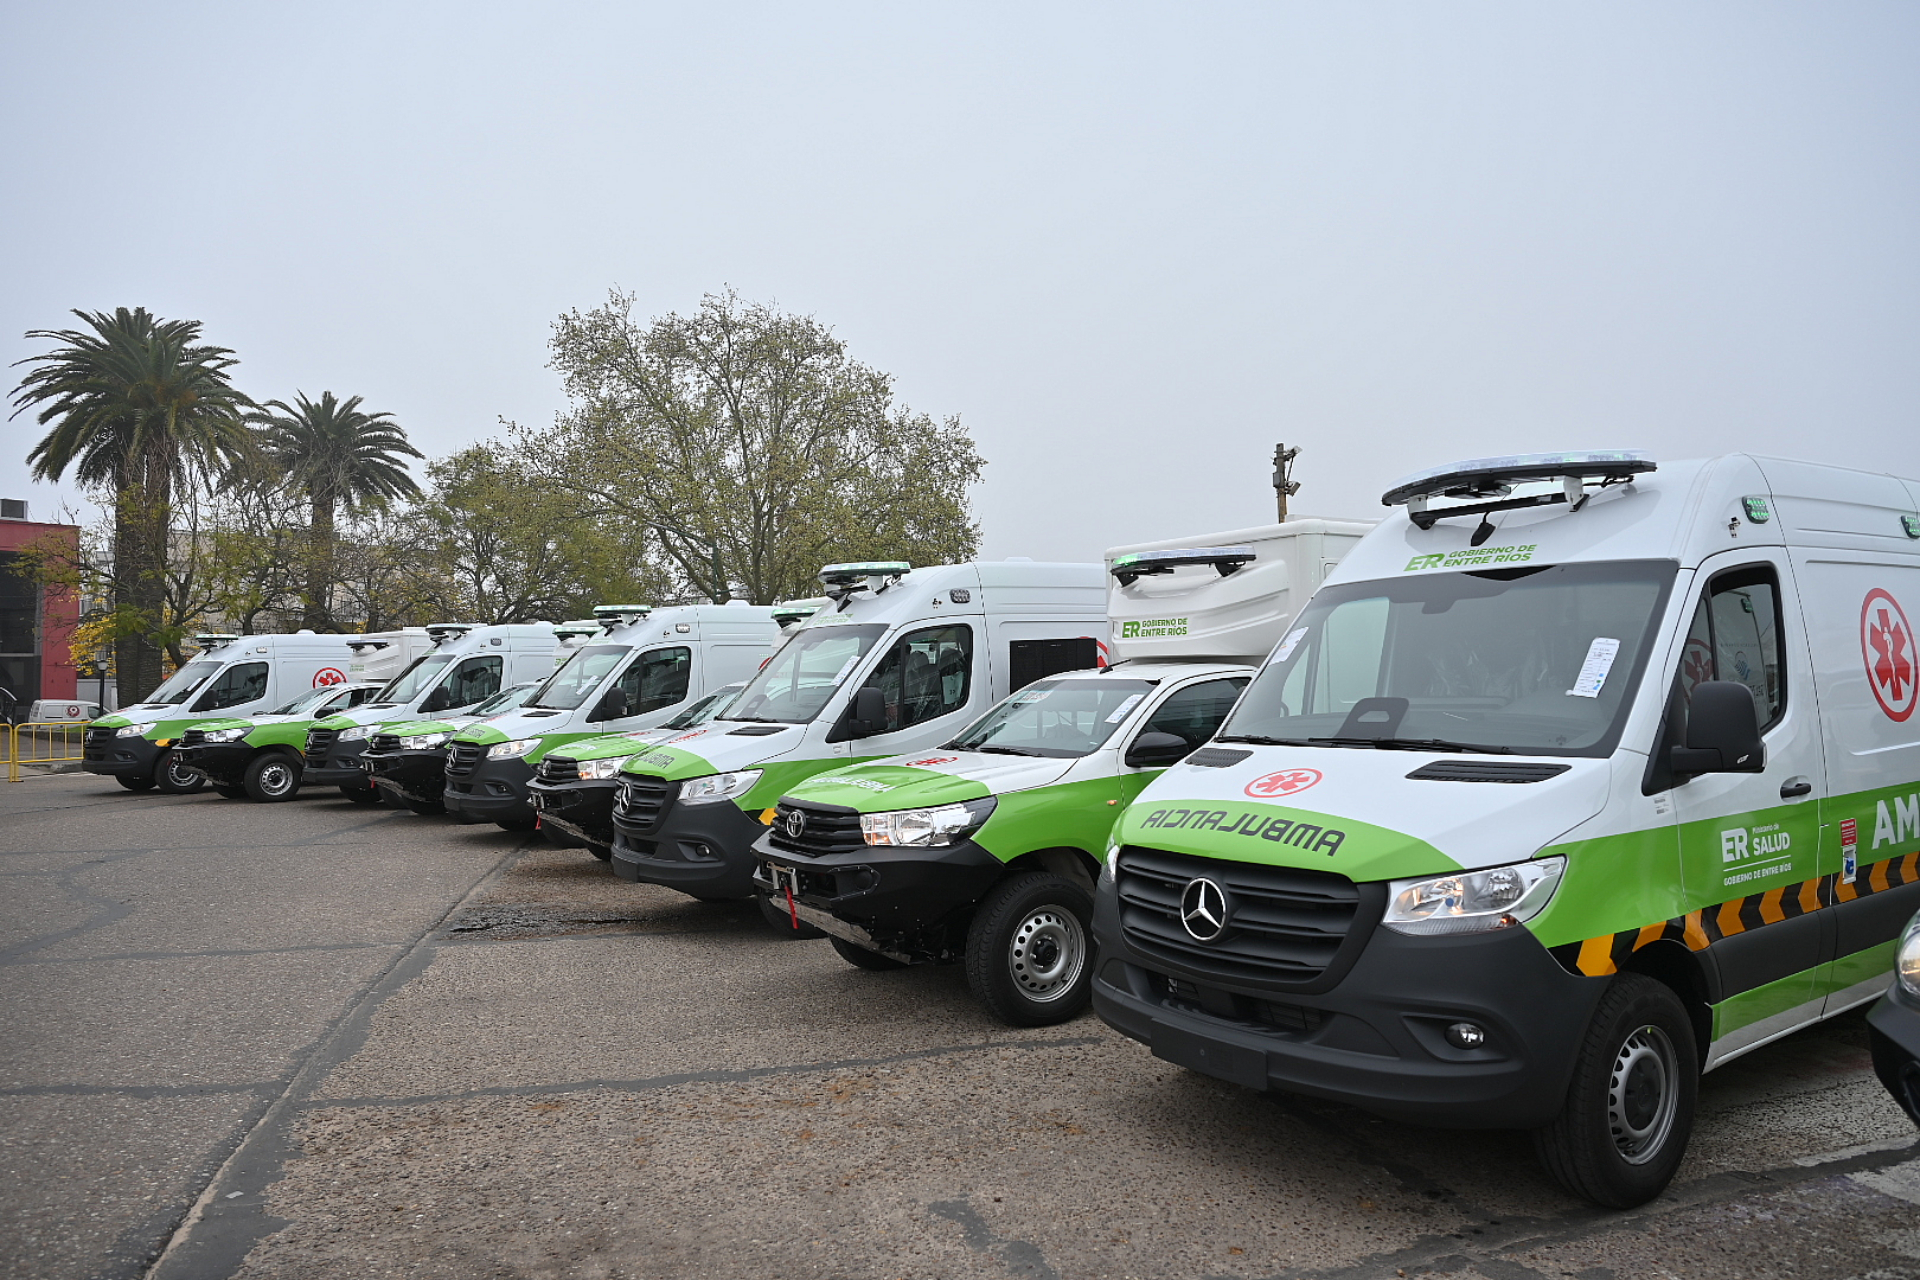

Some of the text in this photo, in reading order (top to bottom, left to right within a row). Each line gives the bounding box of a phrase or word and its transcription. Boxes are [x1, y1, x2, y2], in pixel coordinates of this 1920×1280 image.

[1448, 544, 1537, 558] GOBIERNO DE
[1404, 553, 1445, 571] ER
[1443, 555, 1492, 567] ENTRE
[1122, 621, 1140, 638] ER
[1142, 619, 1176, 628] GOBIERNO
[1141, 628, 1166, 637] ENTRE
[1871, 792, 1920, 850] AM
[1721, 827, 1750, 863] ER
[1753, 832, 1790, 856] SALUD
[1723, 872, 1753, 886] GOBIERNO
[1753, 869, 1761, 879] DE
[1761, 865, 1779, 878] ENTRE
